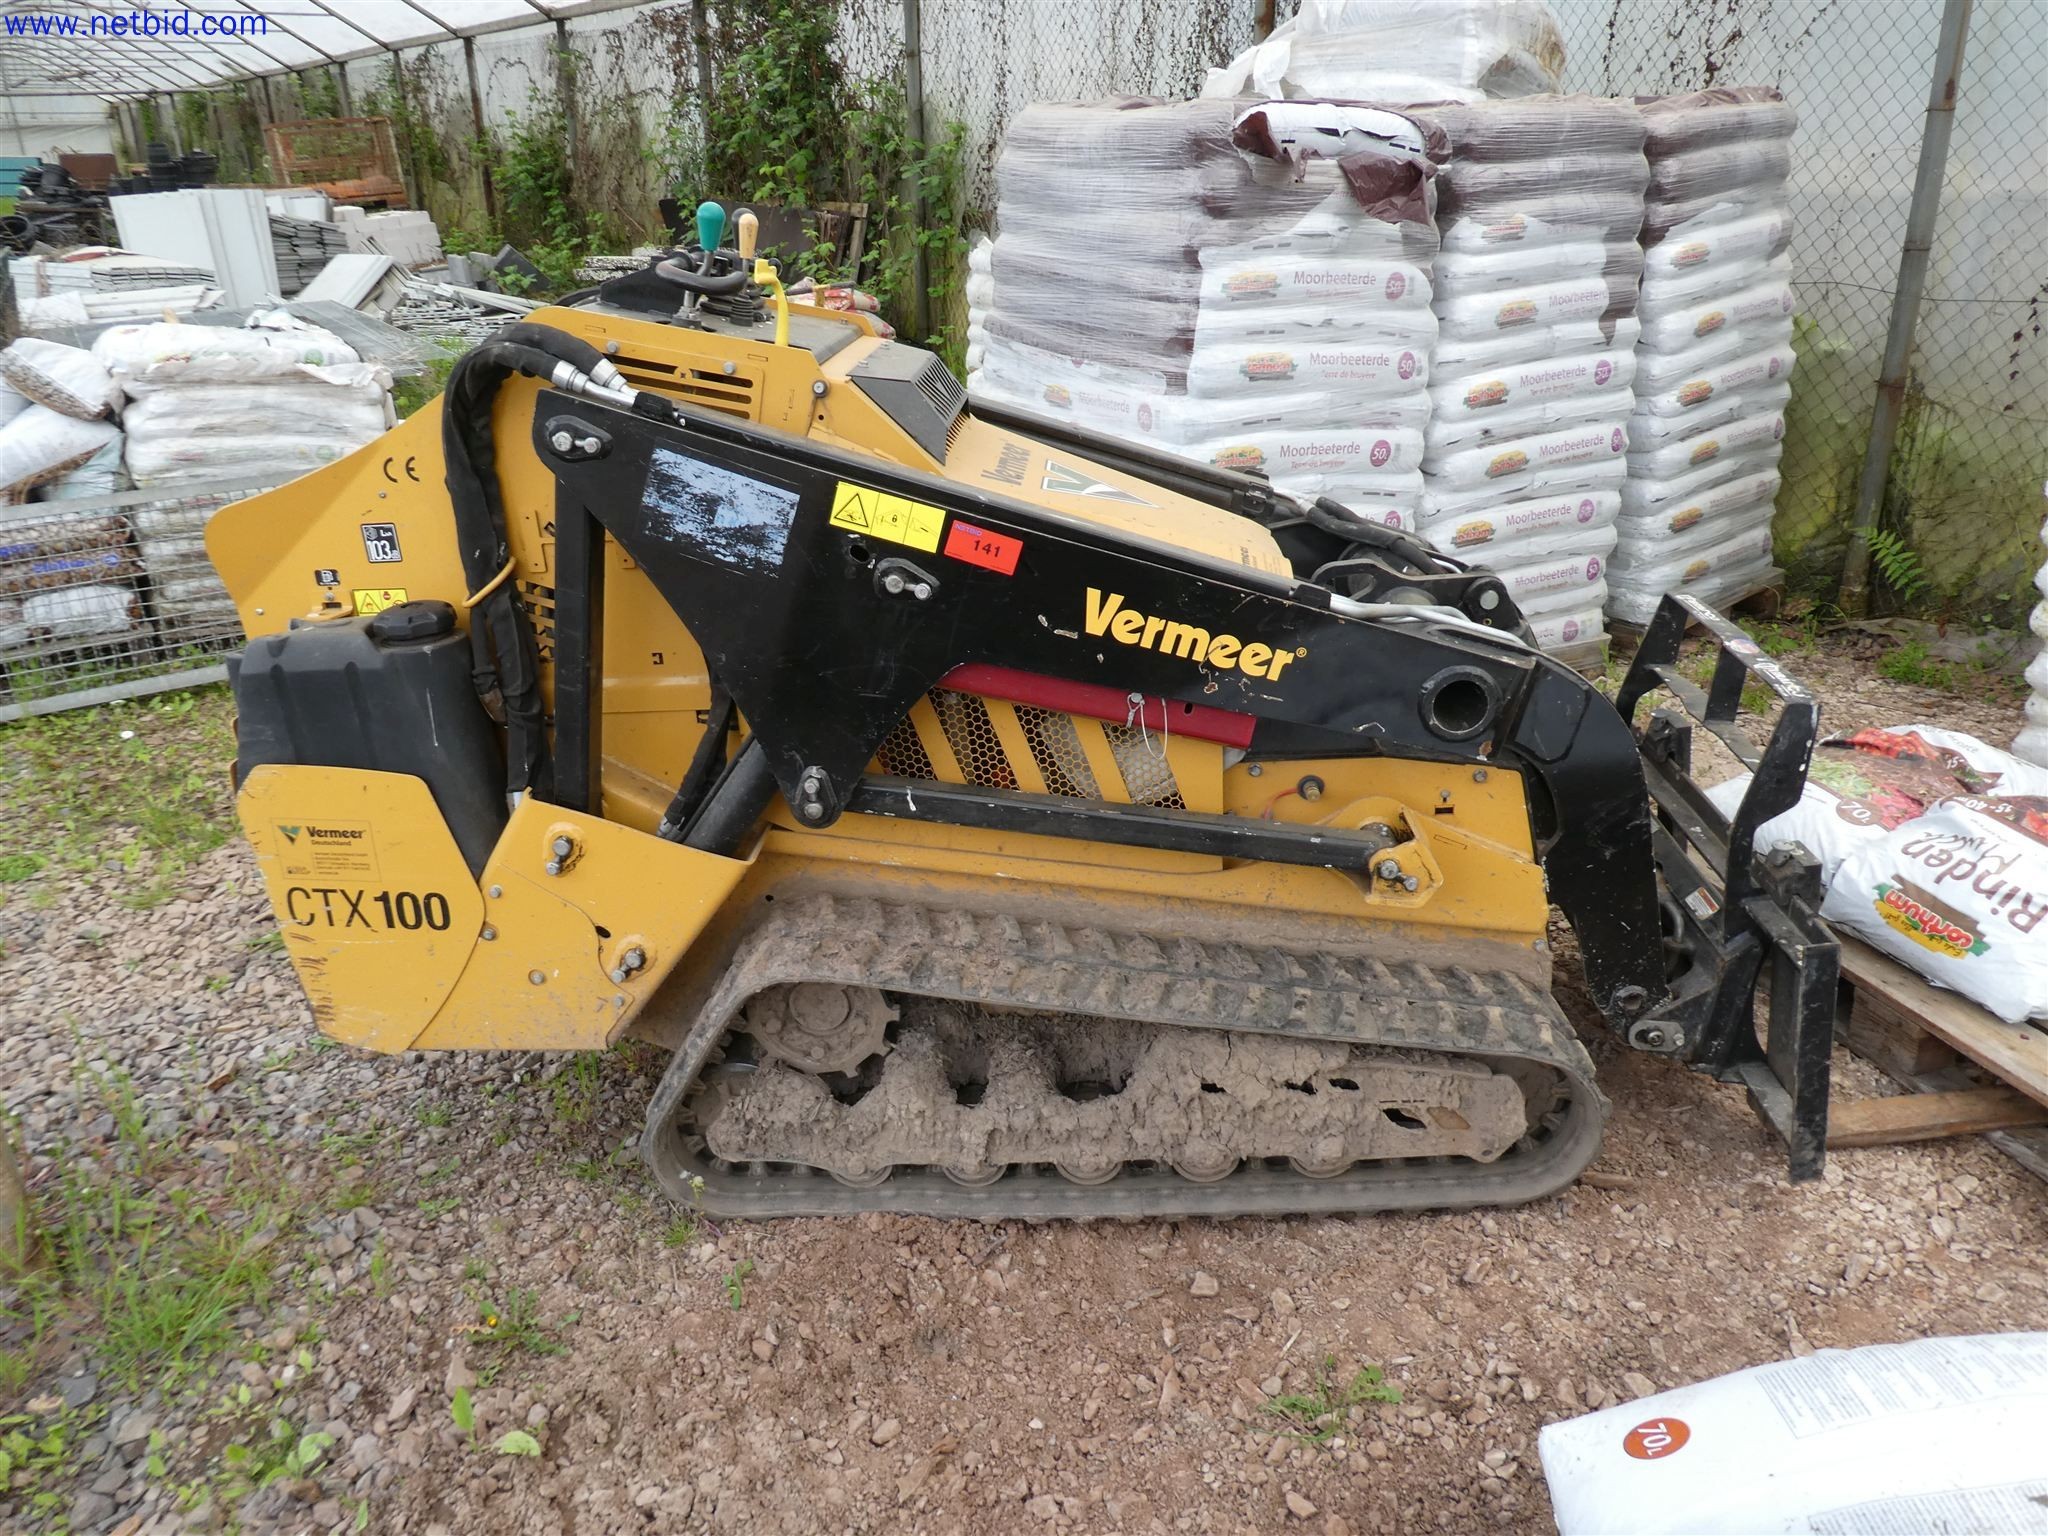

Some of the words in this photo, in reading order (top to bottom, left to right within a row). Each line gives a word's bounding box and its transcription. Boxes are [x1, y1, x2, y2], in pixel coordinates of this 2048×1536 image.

[1294, 271, 1376, 286] Moorbeeterde
[1310, 352, 1390, 366] Moorbeeterde
[1520, 365, 1587, 388] Moorbeeterde
[1280, 441, 1360, 458] Moorbeeterde
[1540, 434, 1605, 457] Moorbeeterde
[980, 442, 1031, 486] Vermeer
[1506, 504, 1572, 527] Moorbeeterde
[974, 539, 1001, 558] 141
[306, 826, 363, 839] Vermeer
[1901, 838, 2048, 934] Rinden
